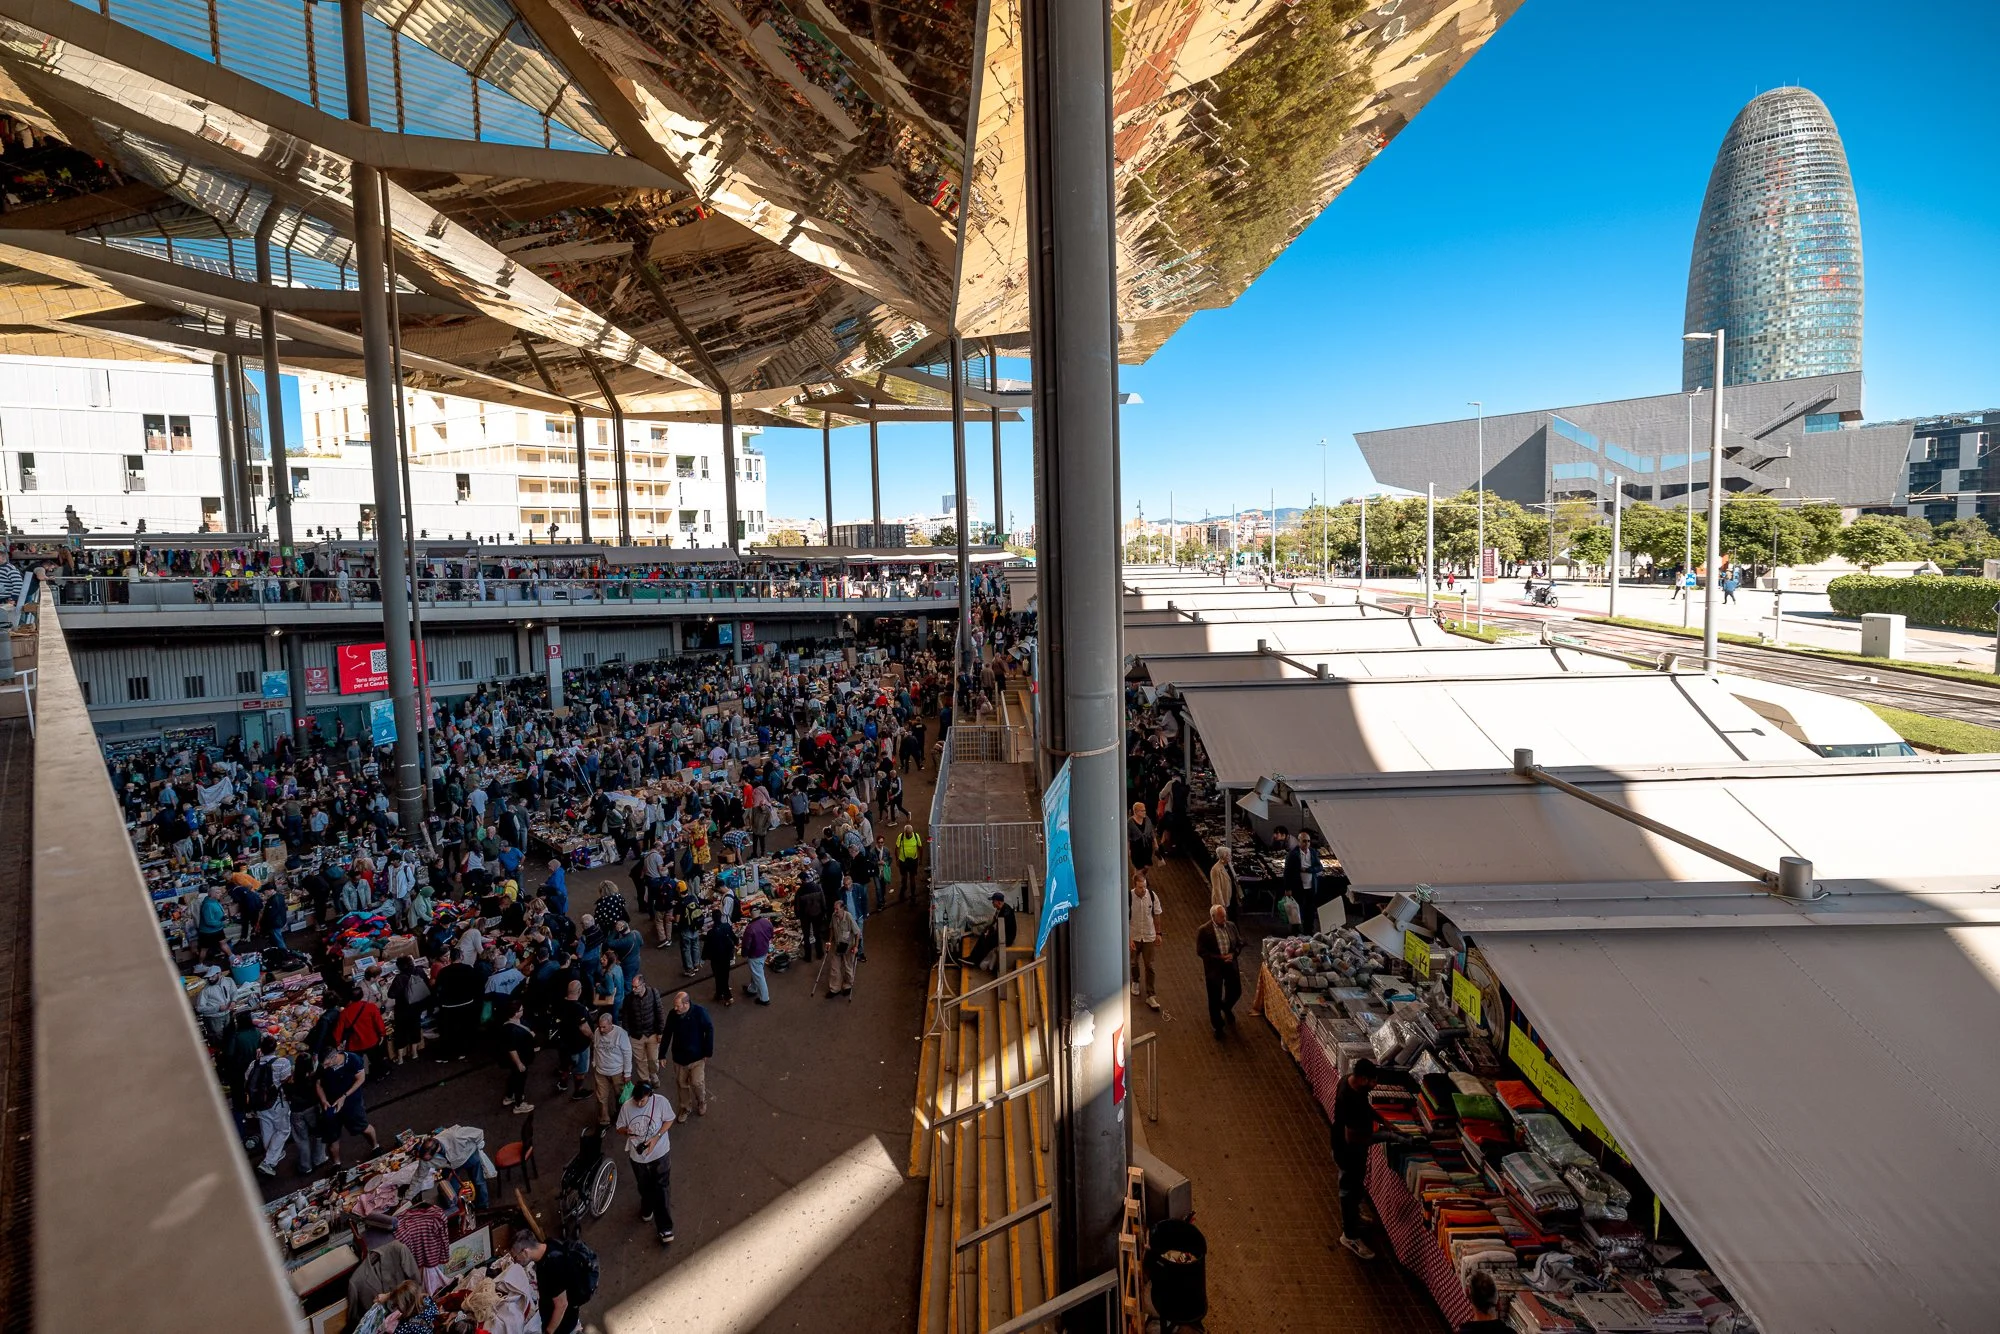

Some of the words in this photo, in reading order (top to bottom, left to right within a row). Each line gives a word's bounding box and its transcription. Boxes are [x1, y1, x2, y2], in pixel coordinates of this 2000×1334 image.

[550, 645, 558, 655] D
[313, 669, 322, 678] D
[298, 719, 305, 727] D
